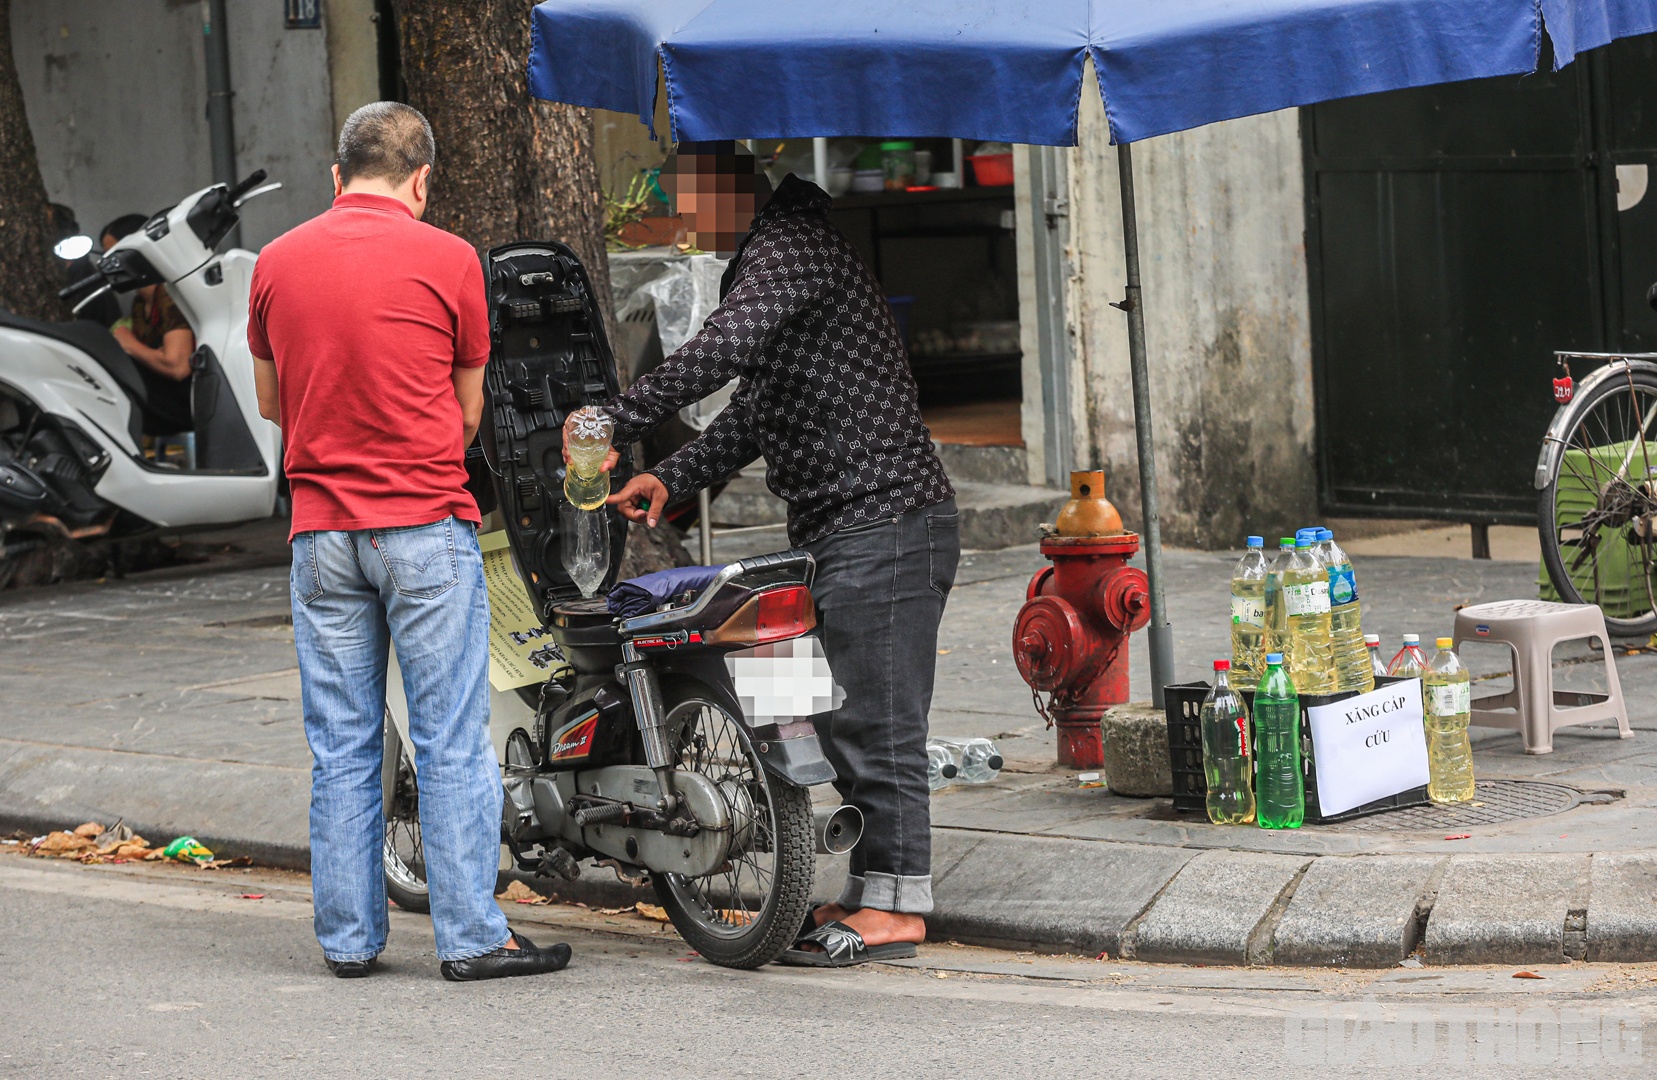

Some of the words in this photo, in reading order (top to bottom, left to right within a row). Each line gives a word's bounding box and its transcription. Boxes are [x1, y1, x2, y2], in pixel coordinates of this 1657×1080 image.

[1345, 704, 1380, 725] XĂNG
[551, 741, 580, 754] Dream
[1365, 730, 1390, 748] CỨU
